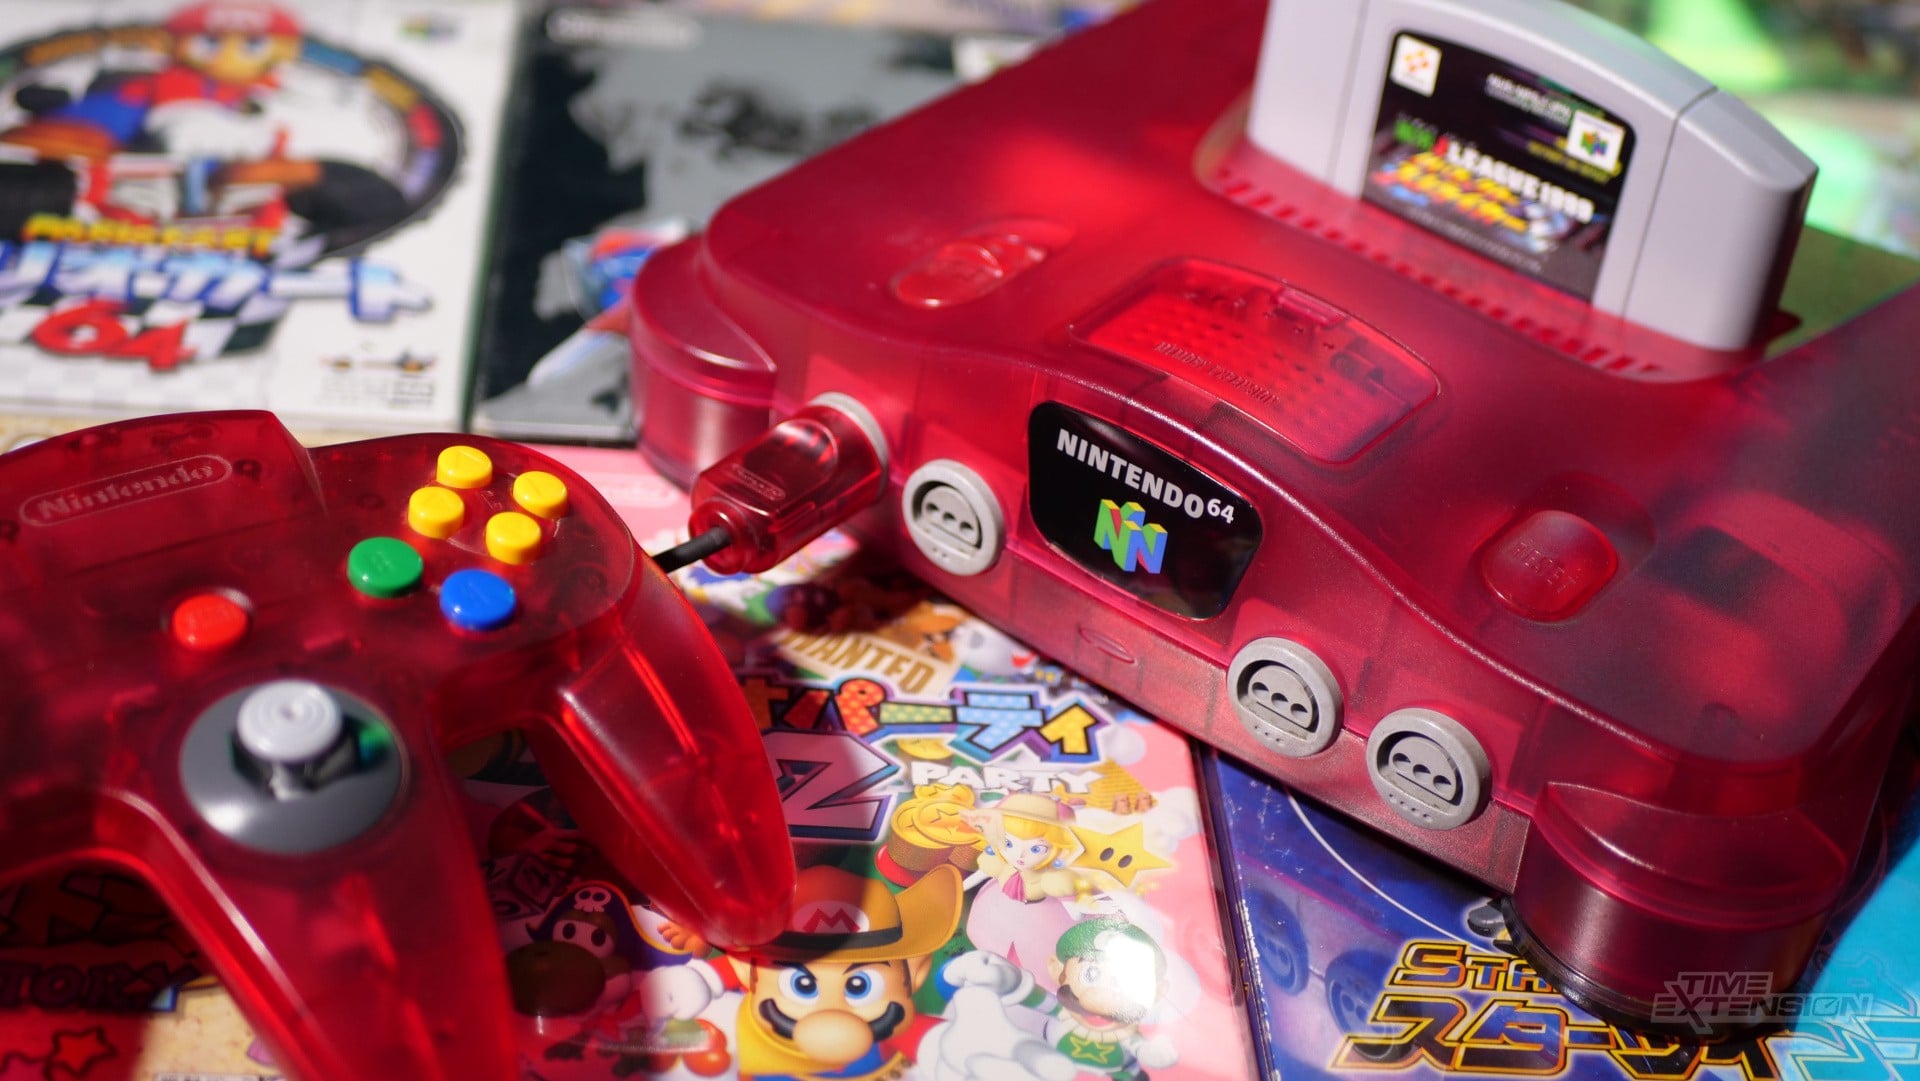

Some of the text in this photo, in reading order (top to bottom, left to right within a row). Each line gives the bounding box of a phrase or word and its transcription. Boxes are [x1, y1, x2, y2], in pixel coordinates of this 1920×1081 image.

[32, 297, 197, 372] 64
[36, 464, 214, 519] Nintendo
[1056, 428, 1235, 524] NINTENDO 64
[910, 760, 1104, 795] PARTY
[1390, 942, 1558, 993] STA
